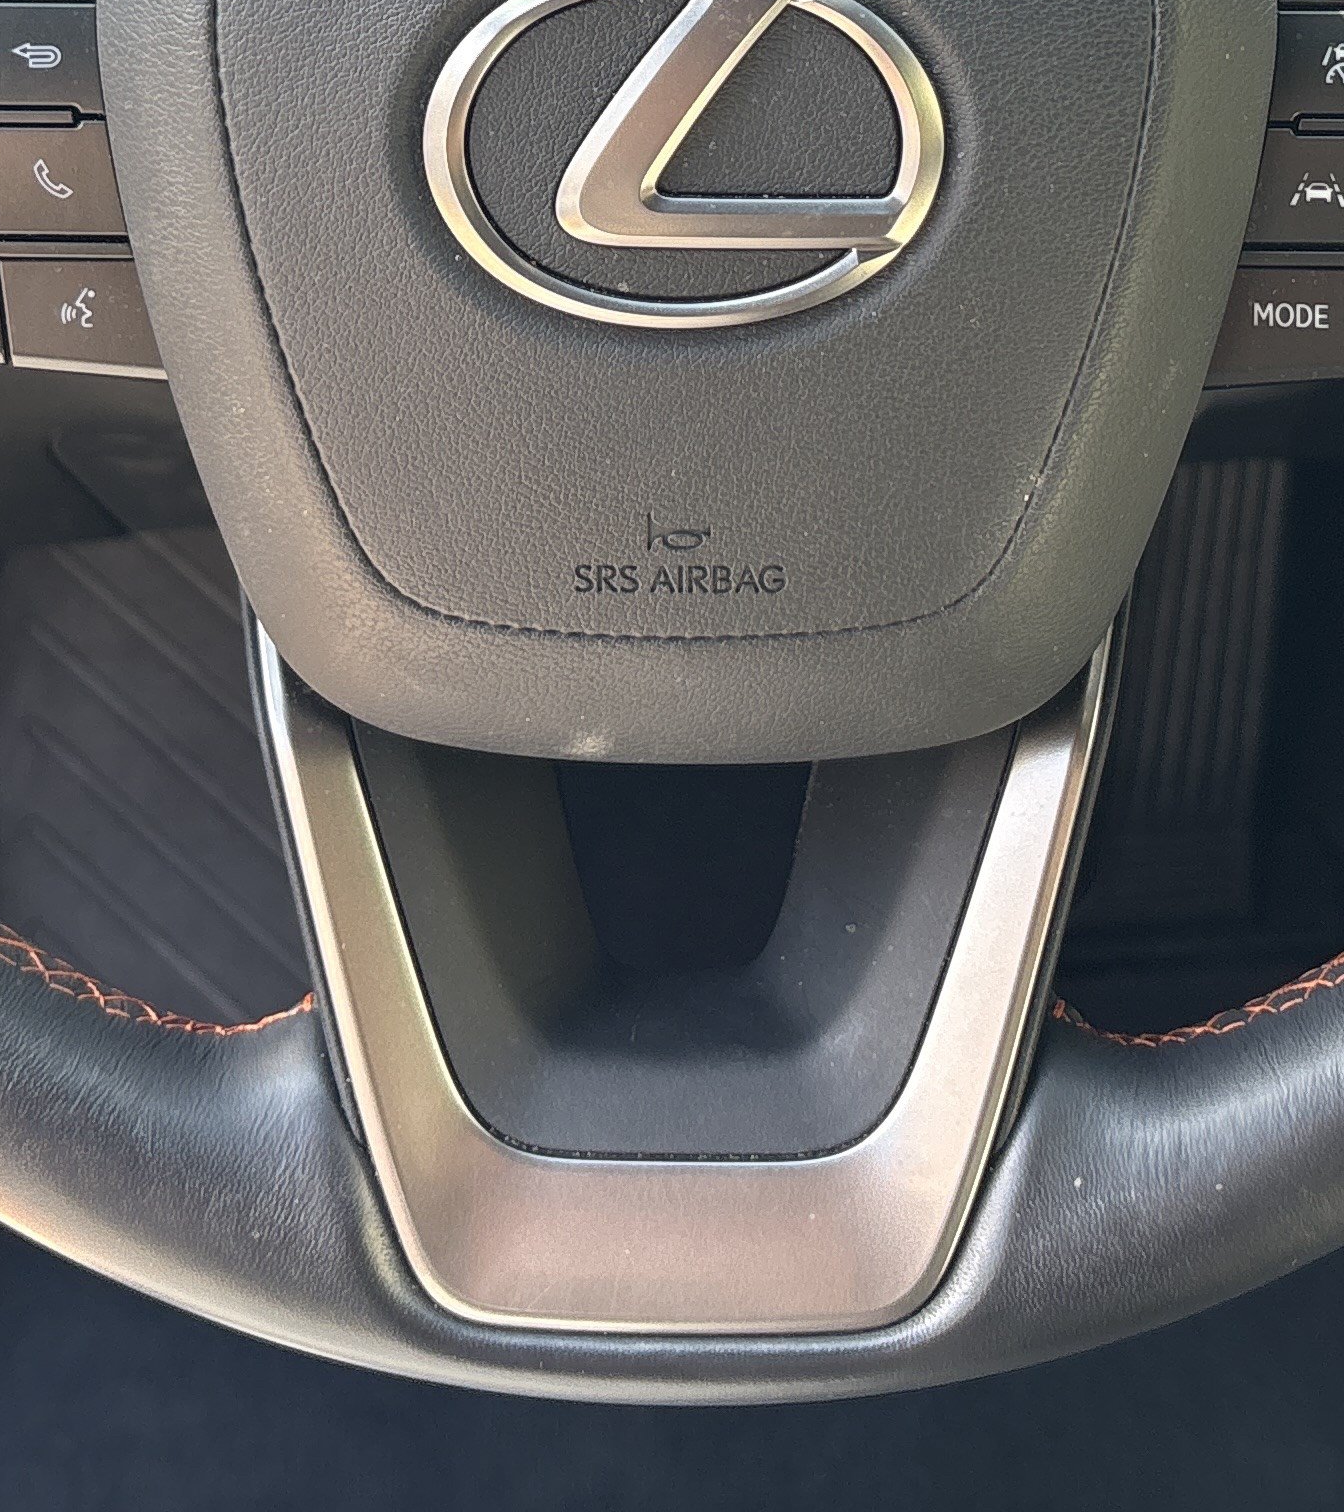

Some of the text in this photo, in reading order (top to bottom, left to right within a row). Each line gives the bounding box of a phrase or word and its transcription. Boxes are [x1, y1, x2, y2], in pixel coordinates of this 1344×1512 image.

[1252, 302, 1330, 330] MODE
[574, 563, 787, 594] SRS AIRBAG
